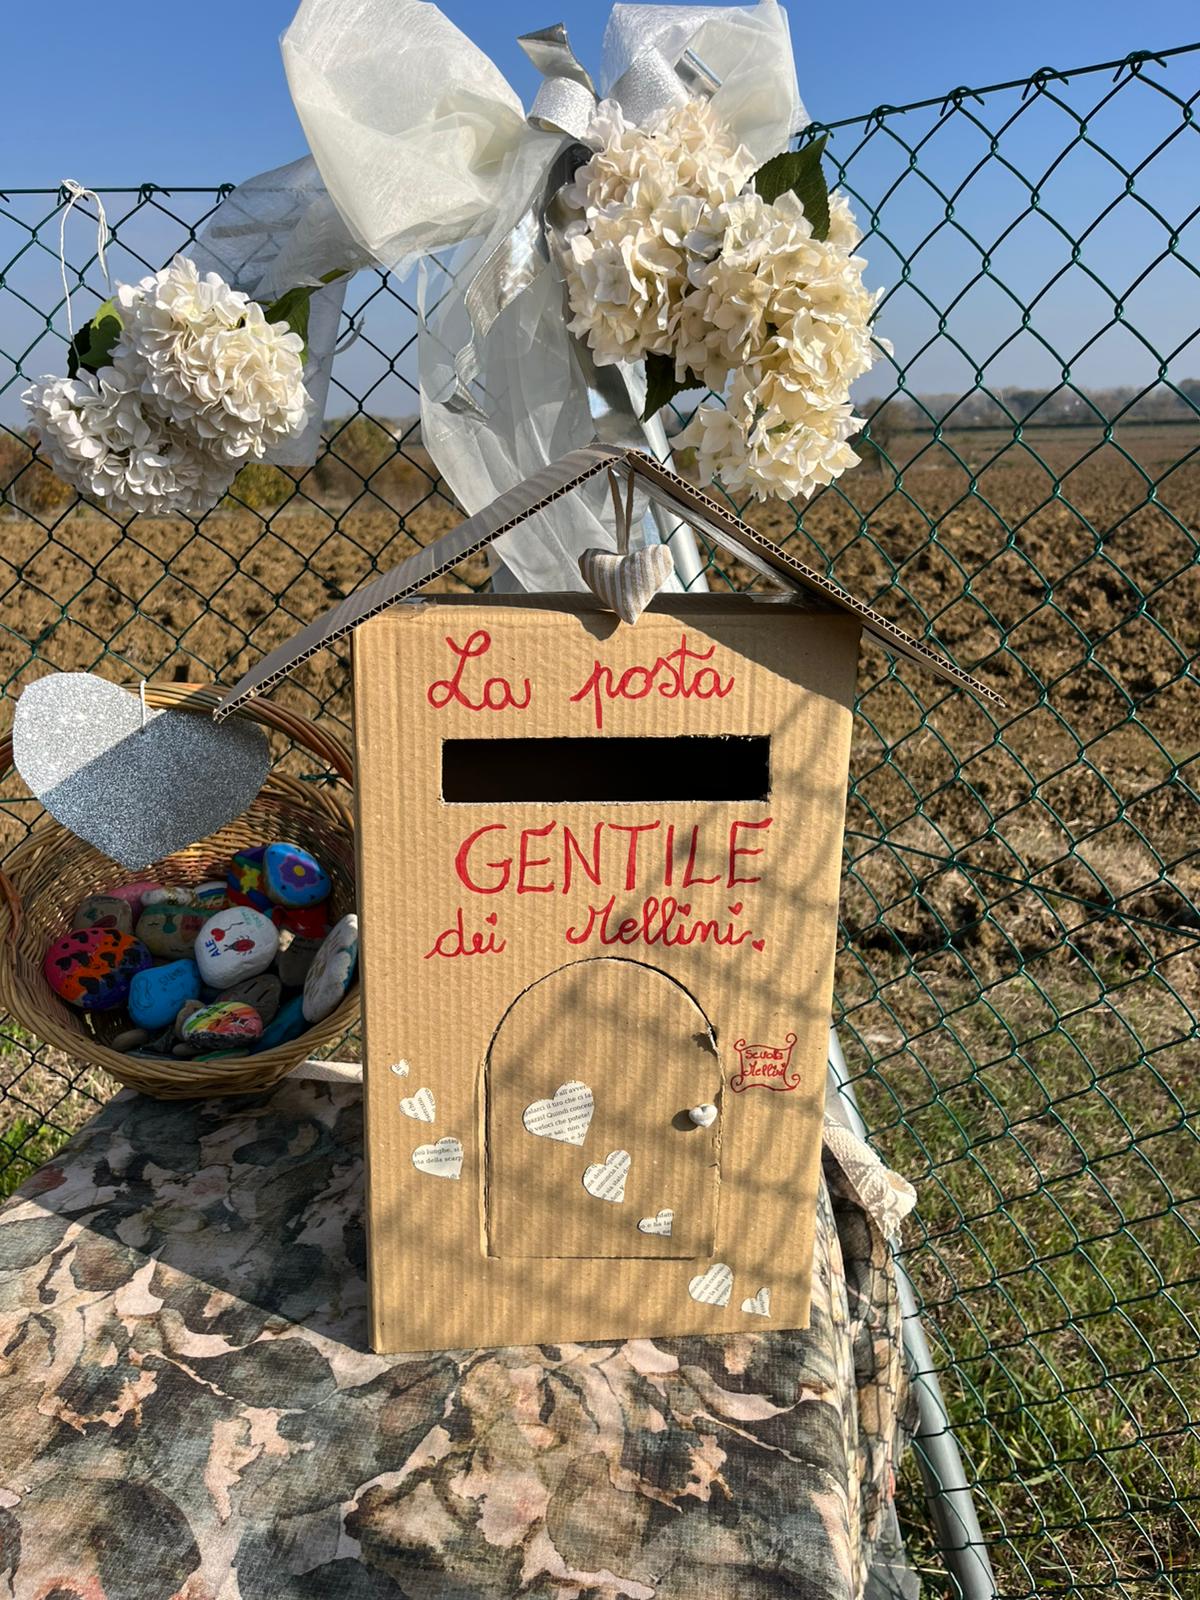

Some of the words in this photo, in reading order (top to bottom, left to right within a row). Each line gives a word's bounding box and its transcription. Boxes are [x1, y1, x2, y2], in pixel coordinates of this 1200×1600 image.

[428, 630, 530, 711] La
[570, 634, 734, 728] posta
[455, 817, 773, 894] GENTILE
[424, 907, 506, 959] dei
